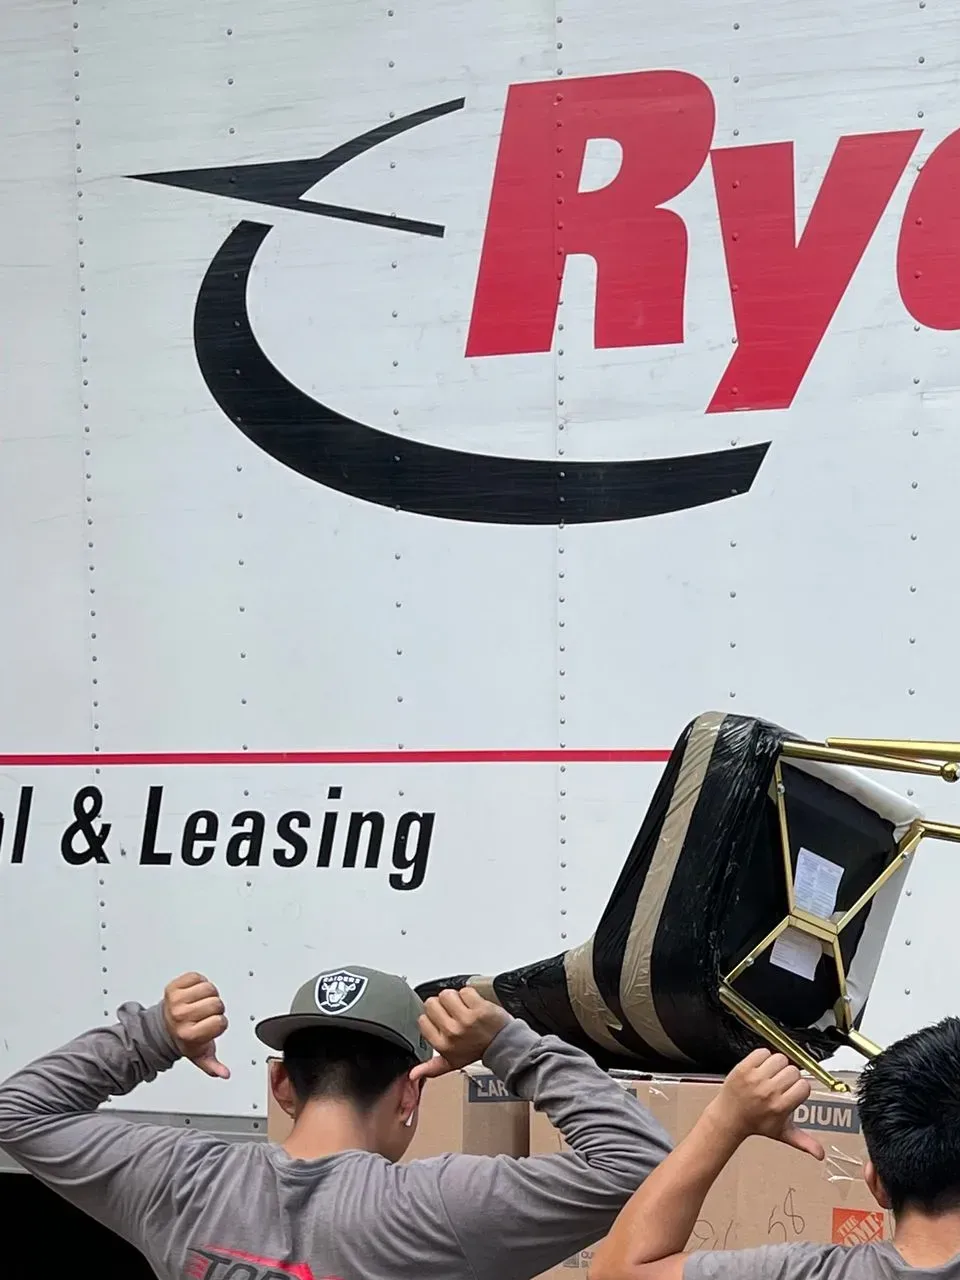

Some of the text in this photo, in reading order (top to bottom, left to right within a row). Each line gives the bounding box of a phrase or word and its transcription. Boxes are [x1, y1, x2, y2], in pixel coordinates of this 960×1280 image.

[61, 786, 111, 865] &
[140, 786, 436, 890] Leasing
[844, 1211, 885, 1246] OME
